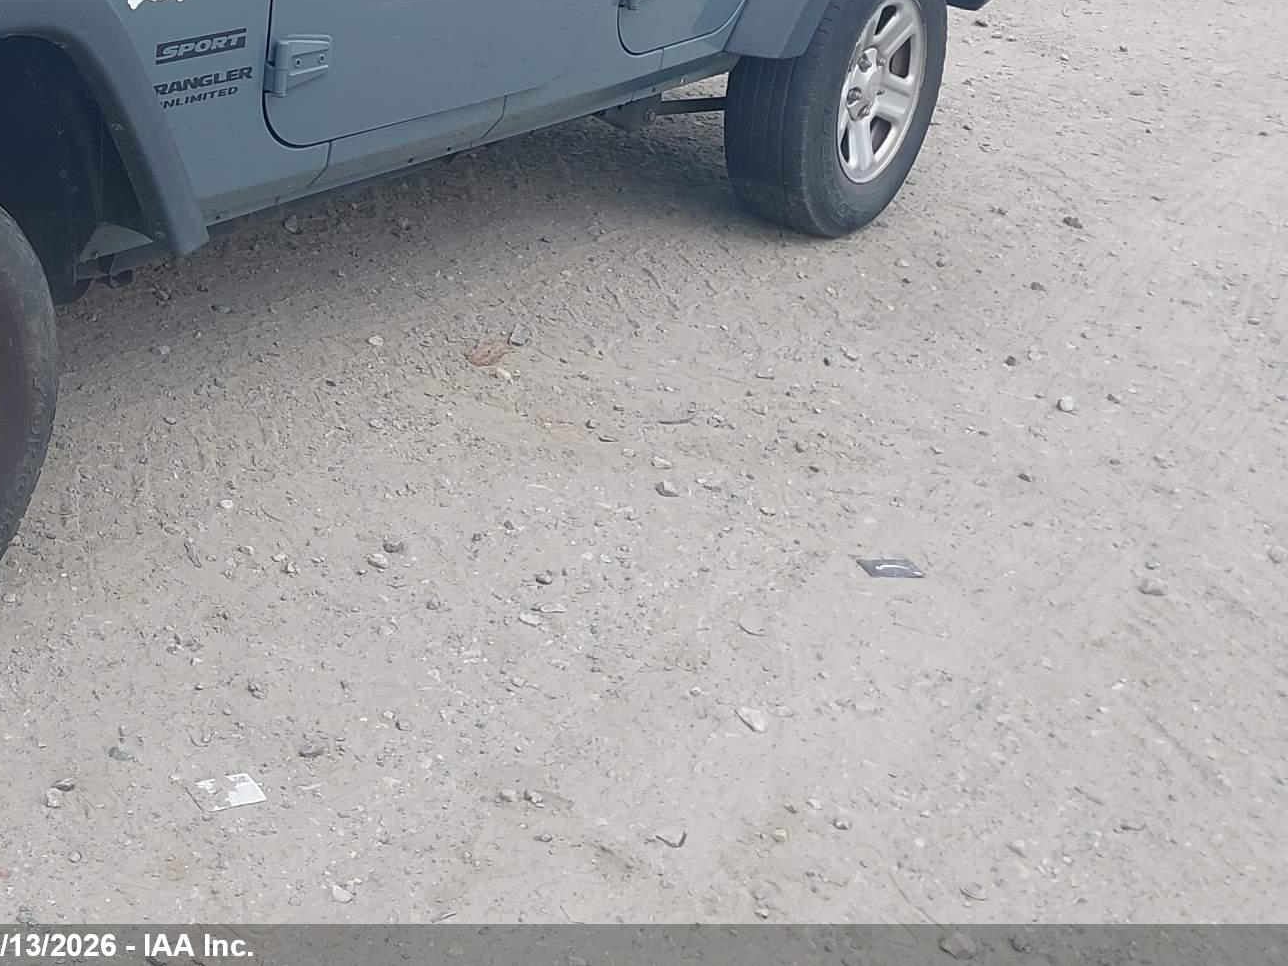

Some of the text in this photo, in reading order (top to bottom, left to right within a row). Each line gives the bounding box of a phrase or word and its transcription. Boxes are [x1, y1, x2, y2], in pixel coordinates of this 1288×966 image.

[156, 32, 247, 60] SPORT
[153, 66, 253, 96] RANGLER
[159, 86, 238, 109] NLIMITED
